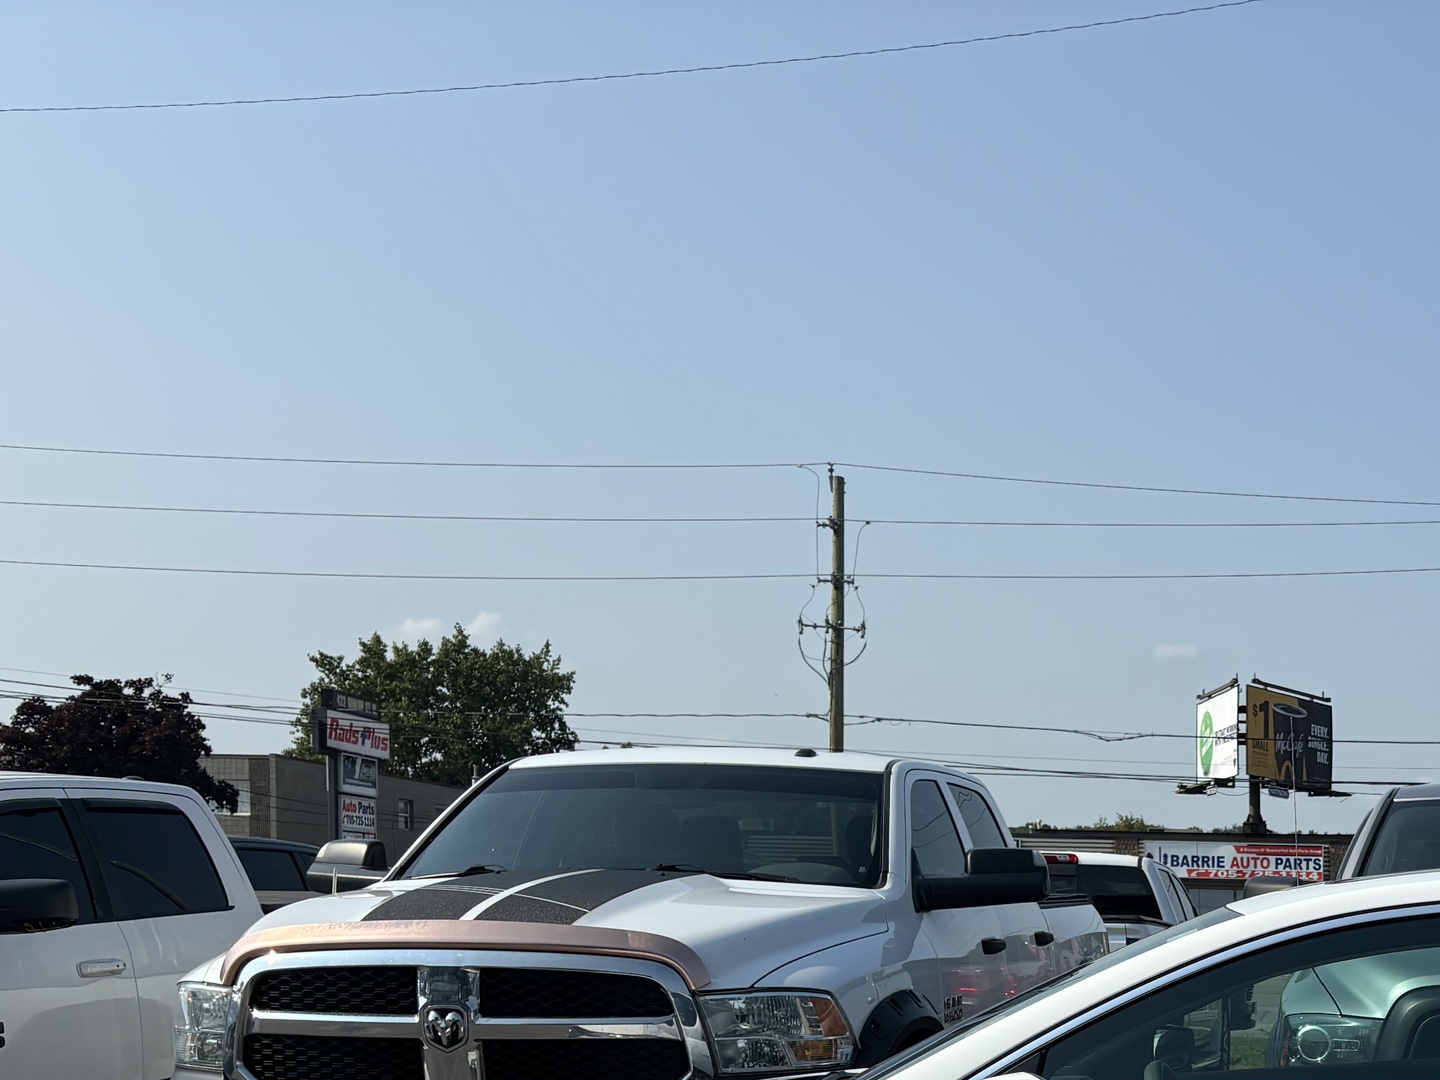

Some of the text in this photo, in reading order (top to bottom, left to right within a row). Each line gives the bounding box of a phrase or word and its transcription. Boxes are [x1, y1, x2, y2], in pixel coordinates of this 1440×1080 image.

[1310, 723, 1330, 738] EVERY.
[1316, 751, 1330, 765] DAY.
[342, 799, 375, 816] Auto Parts
[1170, 854, 1322, 871] BARRIE AUTO PARTS
